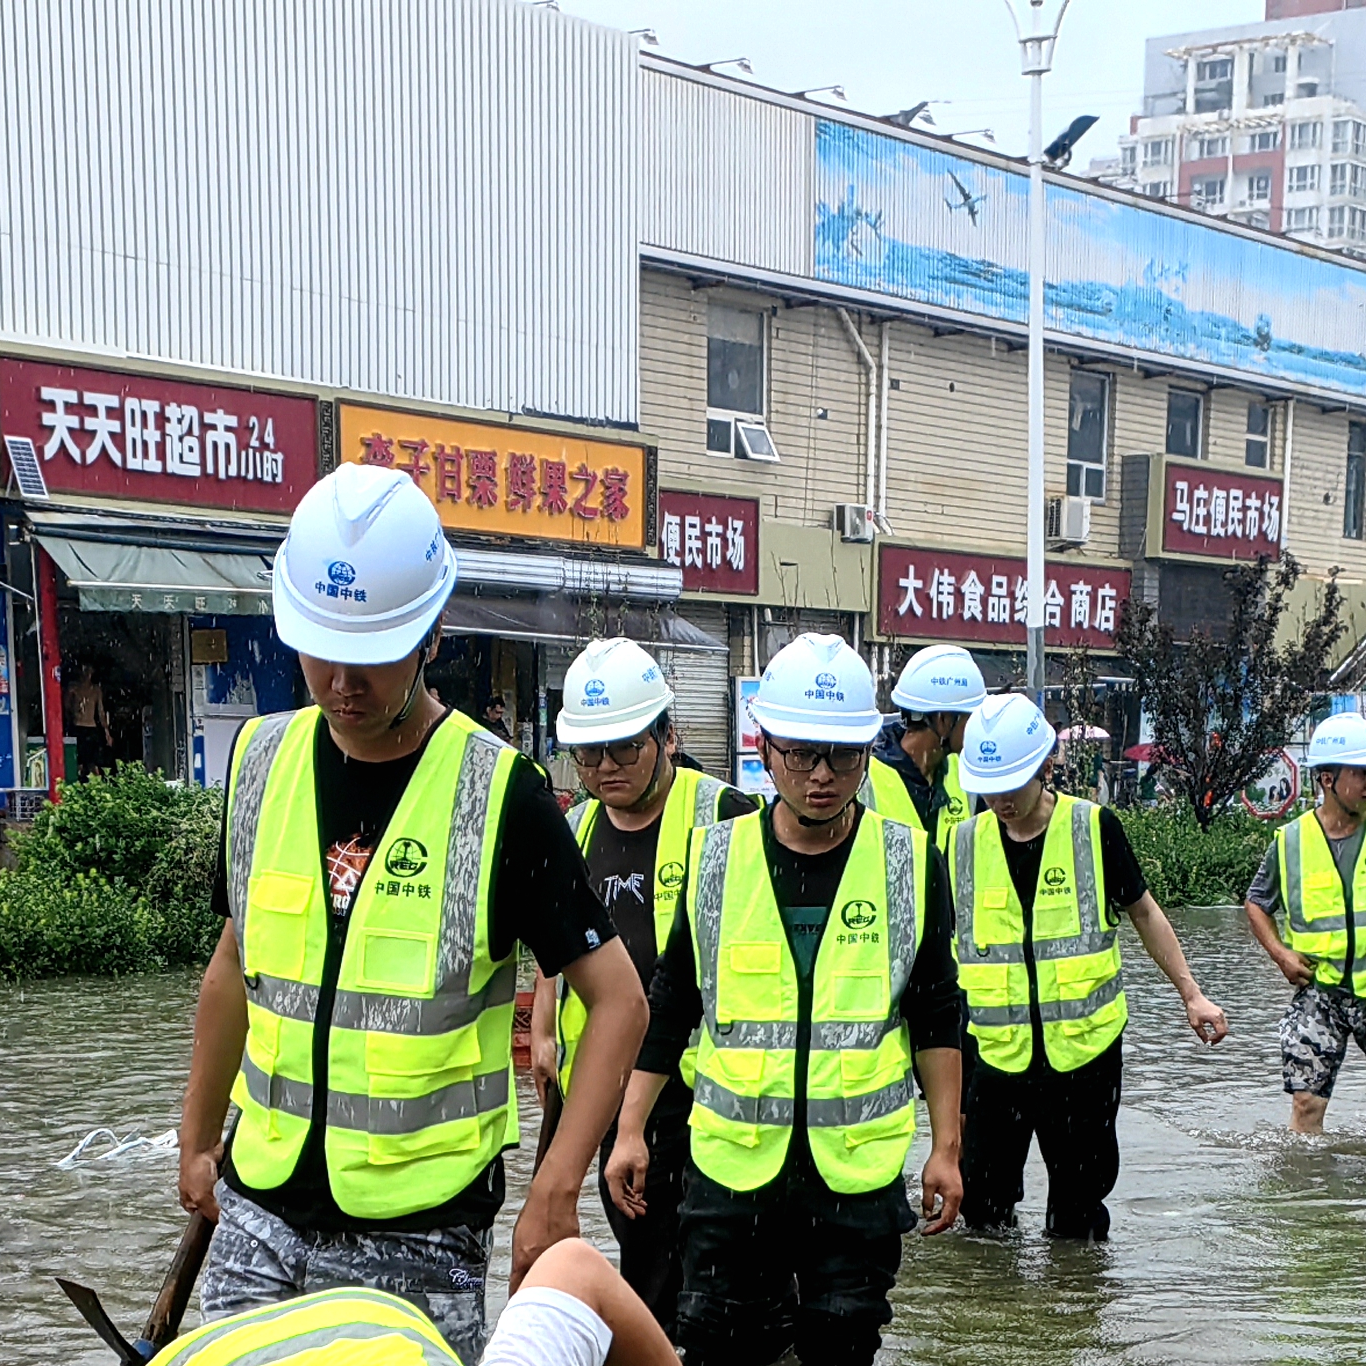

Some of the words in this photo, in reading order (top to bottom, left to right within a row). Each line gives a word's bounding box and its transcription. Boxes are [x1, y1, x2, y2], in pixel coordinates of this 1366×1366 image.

[40, 386, 238, 480] 天天旺超市
[248, 415, 275, 449] 24
[241, 448, 284, 484] 小时
[1171, 481, 1280, 543] 马庄便民市场
[661, 511, 745, 571] 便民市场
[314, 581, 367, 602] 中国中铁
[804, 689, 845, 702] 中国中铁
[930, 676, 968, 688] 中铁广州局
[374, 880, 432, 899] 中国中铁
[836, 931, 880, 946] 中国中铁
